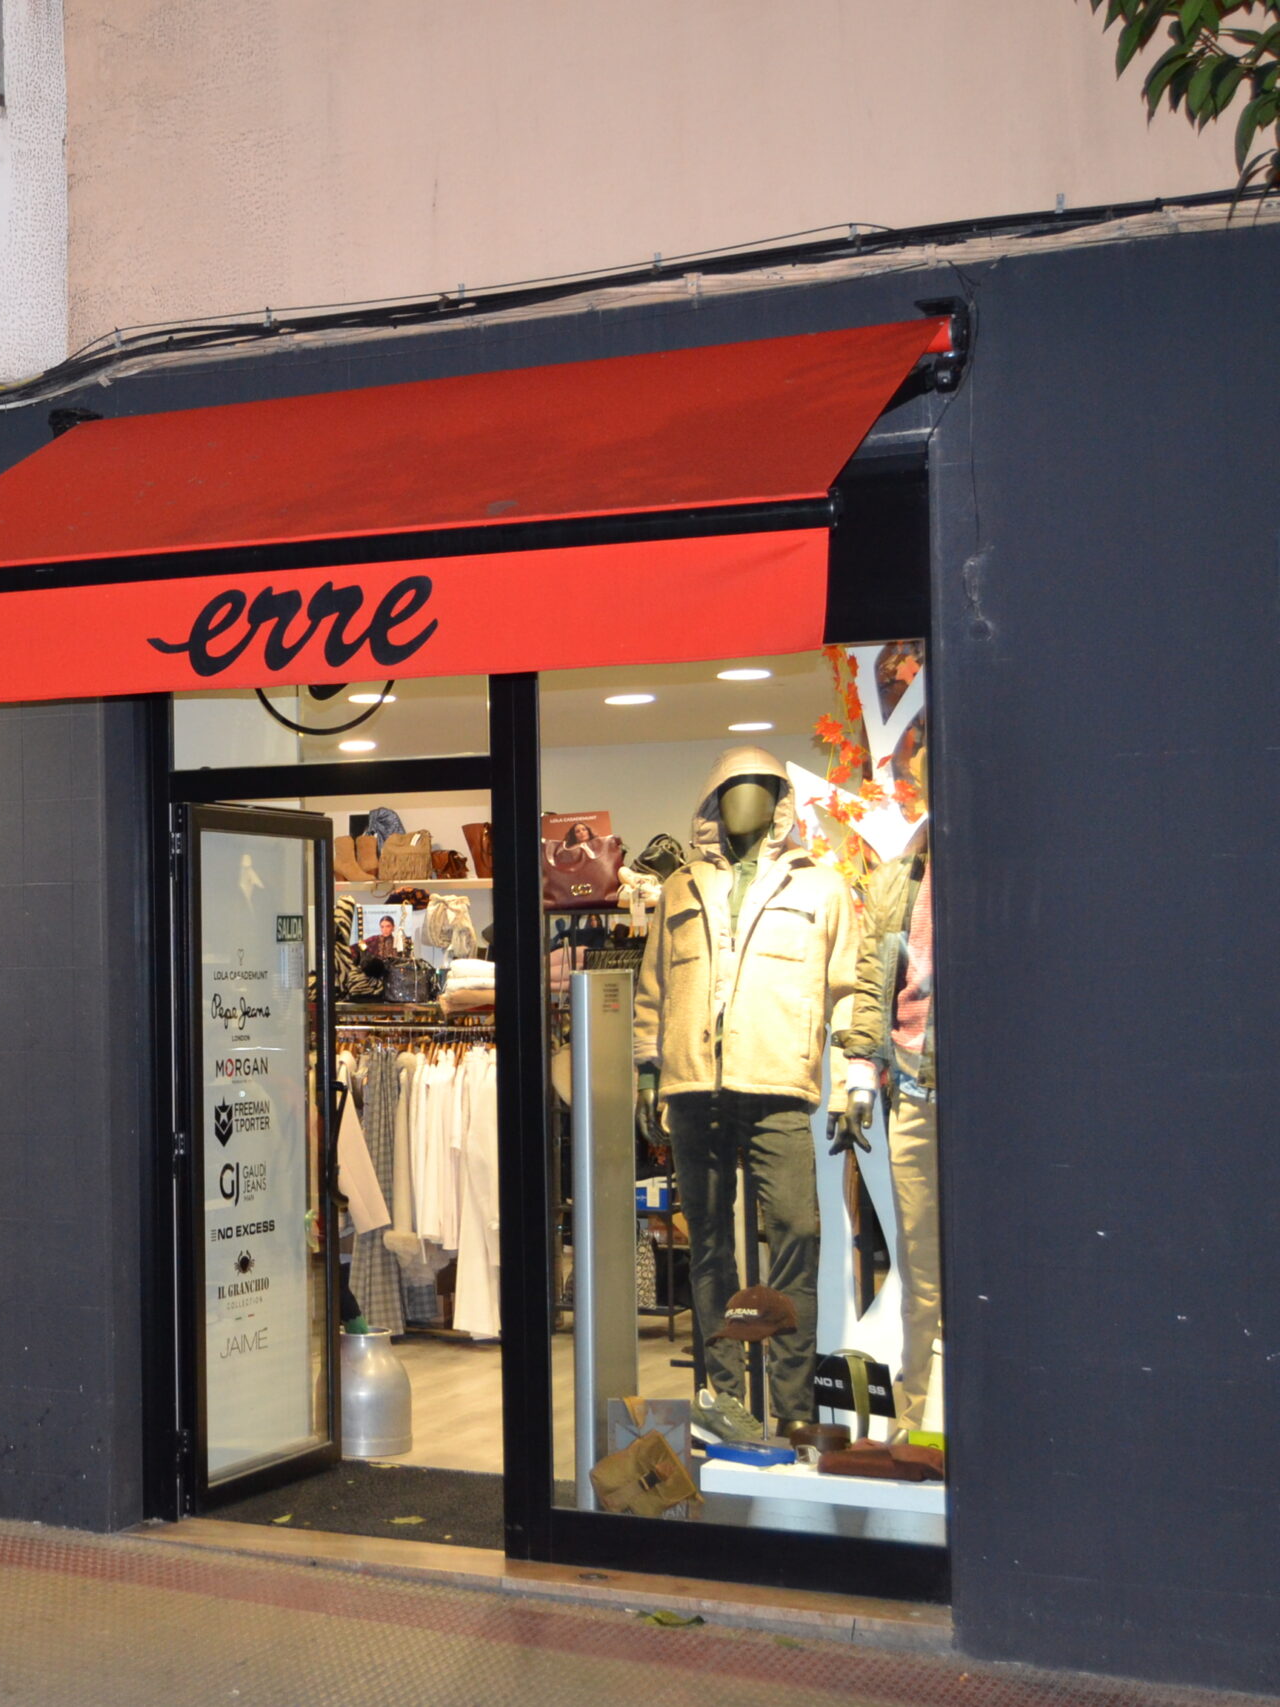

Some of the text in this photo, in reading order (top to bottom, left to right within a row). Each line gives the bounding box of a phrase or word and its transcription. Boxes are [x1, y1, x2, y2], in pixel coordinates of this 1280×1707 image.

[147, 575, 438, 677] erre
[277, 917, 303, 941] SALIDA
[213, 970, 268, 981] LOLA CASADEMUNT
[211, 993, 270, 1030] Pepe Jeans
[215, 1057, 268, 1078] MORGAN
[234, 1100, 270, 1117] FREEMAN
[242, 1177, 267, 1194] JEANS
[217, 1219, 276, 1241] NO EXCESS
[218, 1276, 270, 1300] IL GRANCHIO
[814, 1375, 833, 1387] NO
